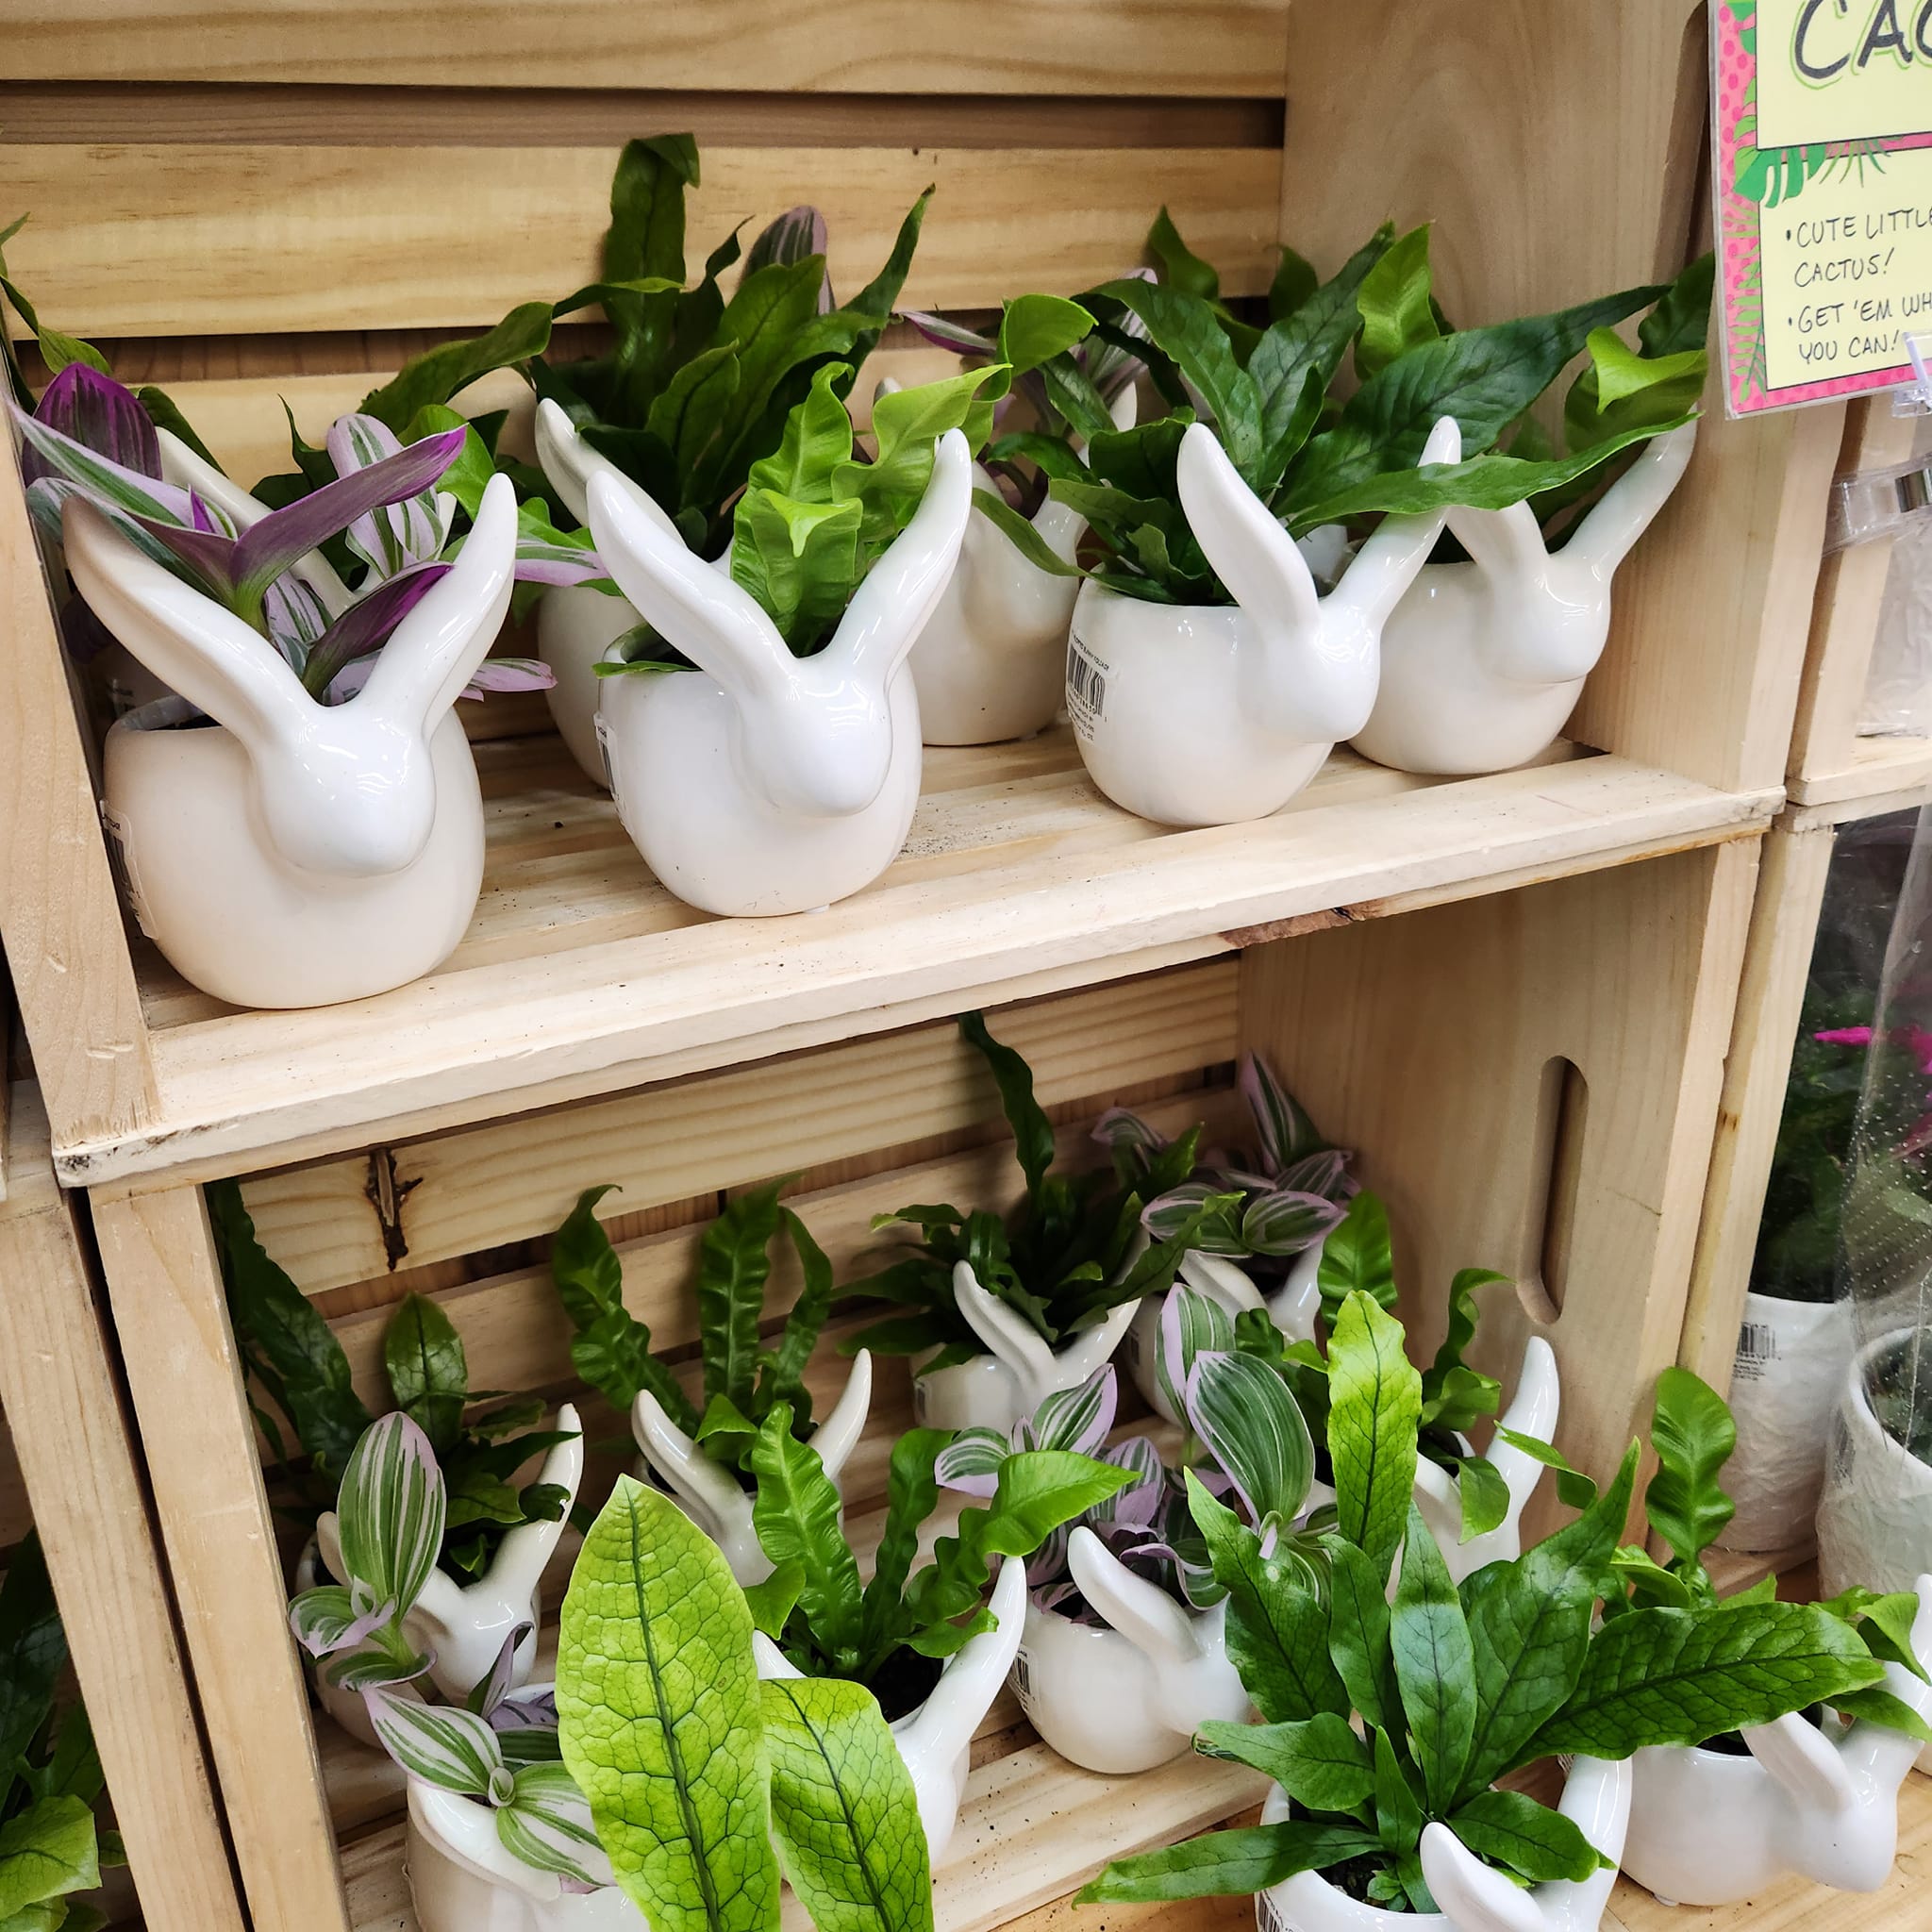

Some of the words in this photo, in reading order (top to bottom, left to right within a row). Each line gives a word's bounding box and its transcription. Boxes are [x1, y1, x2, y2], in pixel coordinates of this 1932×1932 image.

[1794, 0, 1932, 79] CA
[1796, 216, 1857, 248] CUTE
[1866, 206, 1932, 240] LITTL
[1794, 247, 1895, 288] CACTUS!
[1798, 302, 1844, 333] GET
[1854, 298, 1893, 322] 'EM
[1799, 340, 1838, 365] YOU
[1848, 329, 1899, 358] CAN!
